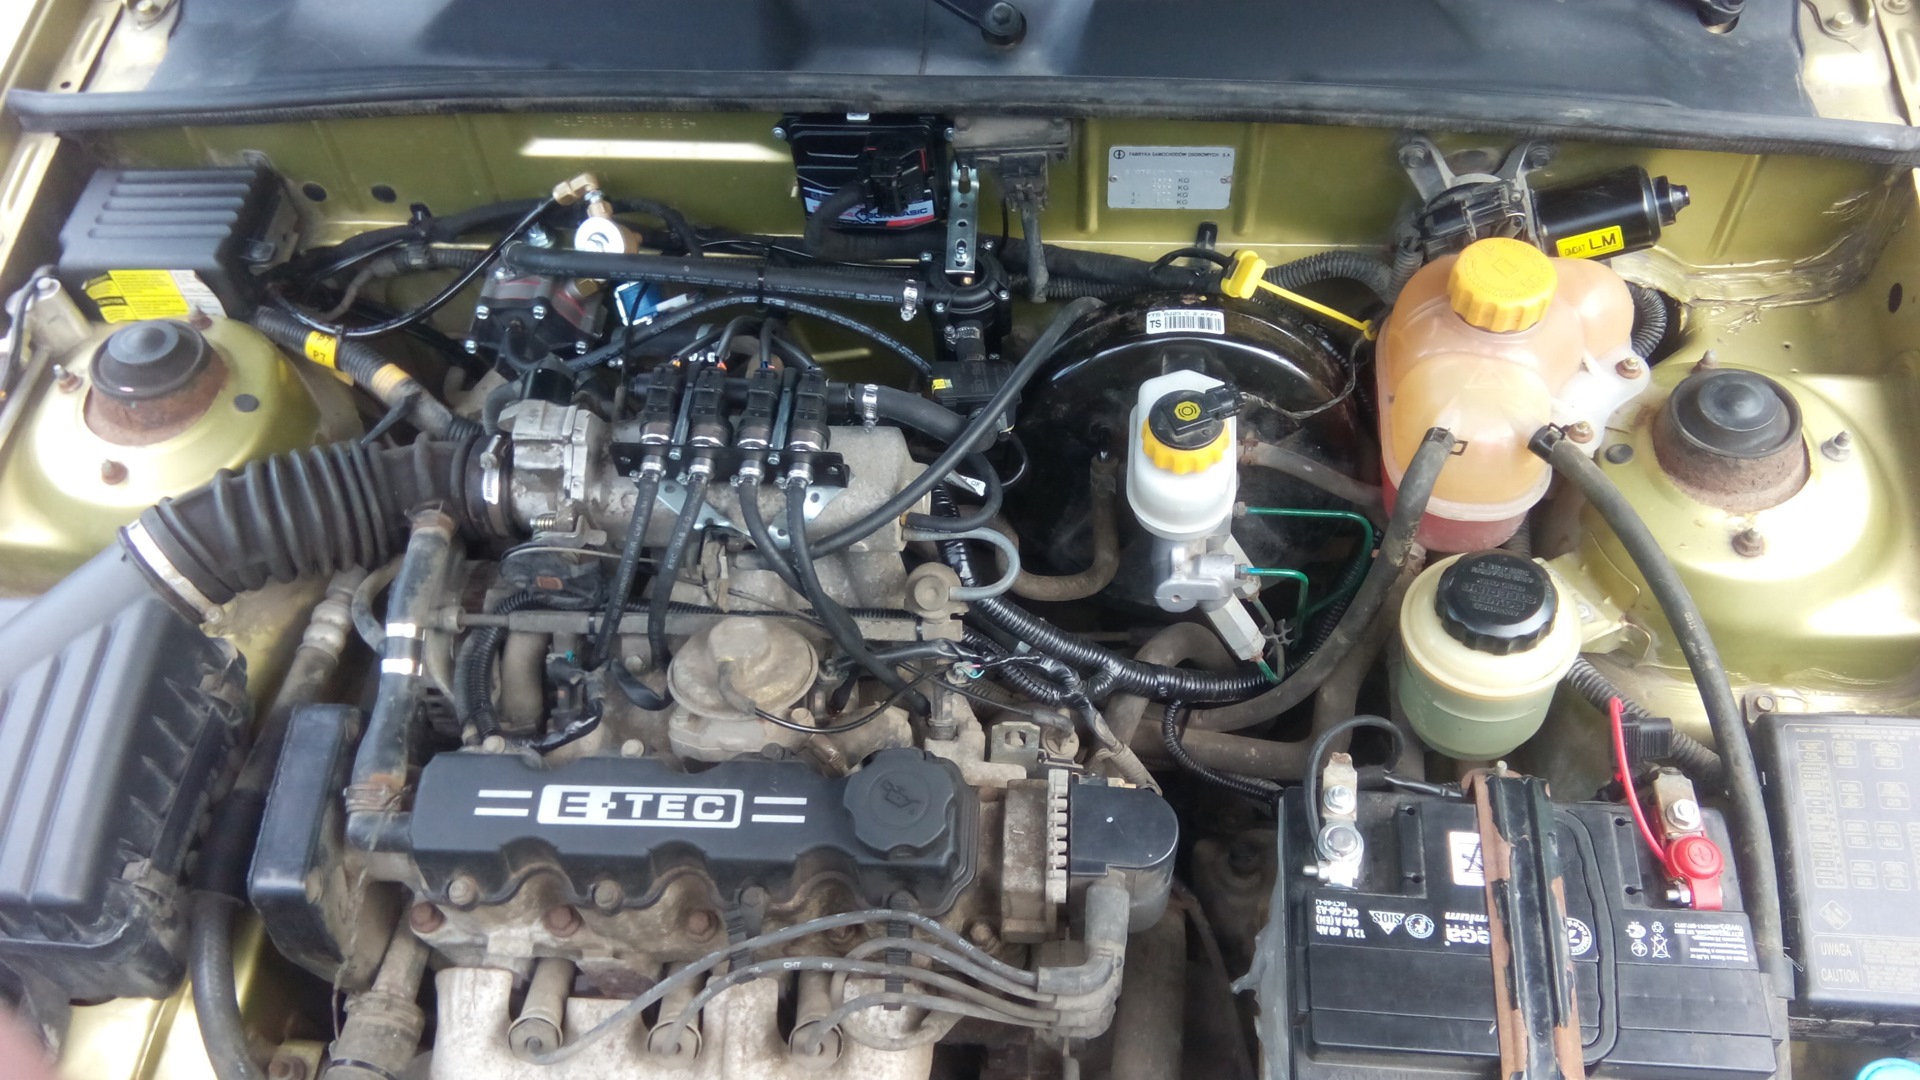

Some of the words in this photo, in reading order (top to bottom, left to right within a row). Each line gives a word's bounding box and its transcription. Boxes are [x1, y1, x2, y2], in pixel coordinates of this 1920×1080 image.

[1588, 232, 1617, 250] LM
[1149, 319, 1162, 328] TS
[313, 350, 326, 362] P7
[1373, 911, 1402, 924] SIOS
[1445, 926, 1491, 946] ega
[1821, 942, 1853, 957] UWAGA
[783, 960, 802, 970] CHT
[1821, 968, 1860, 983] CAUTION
